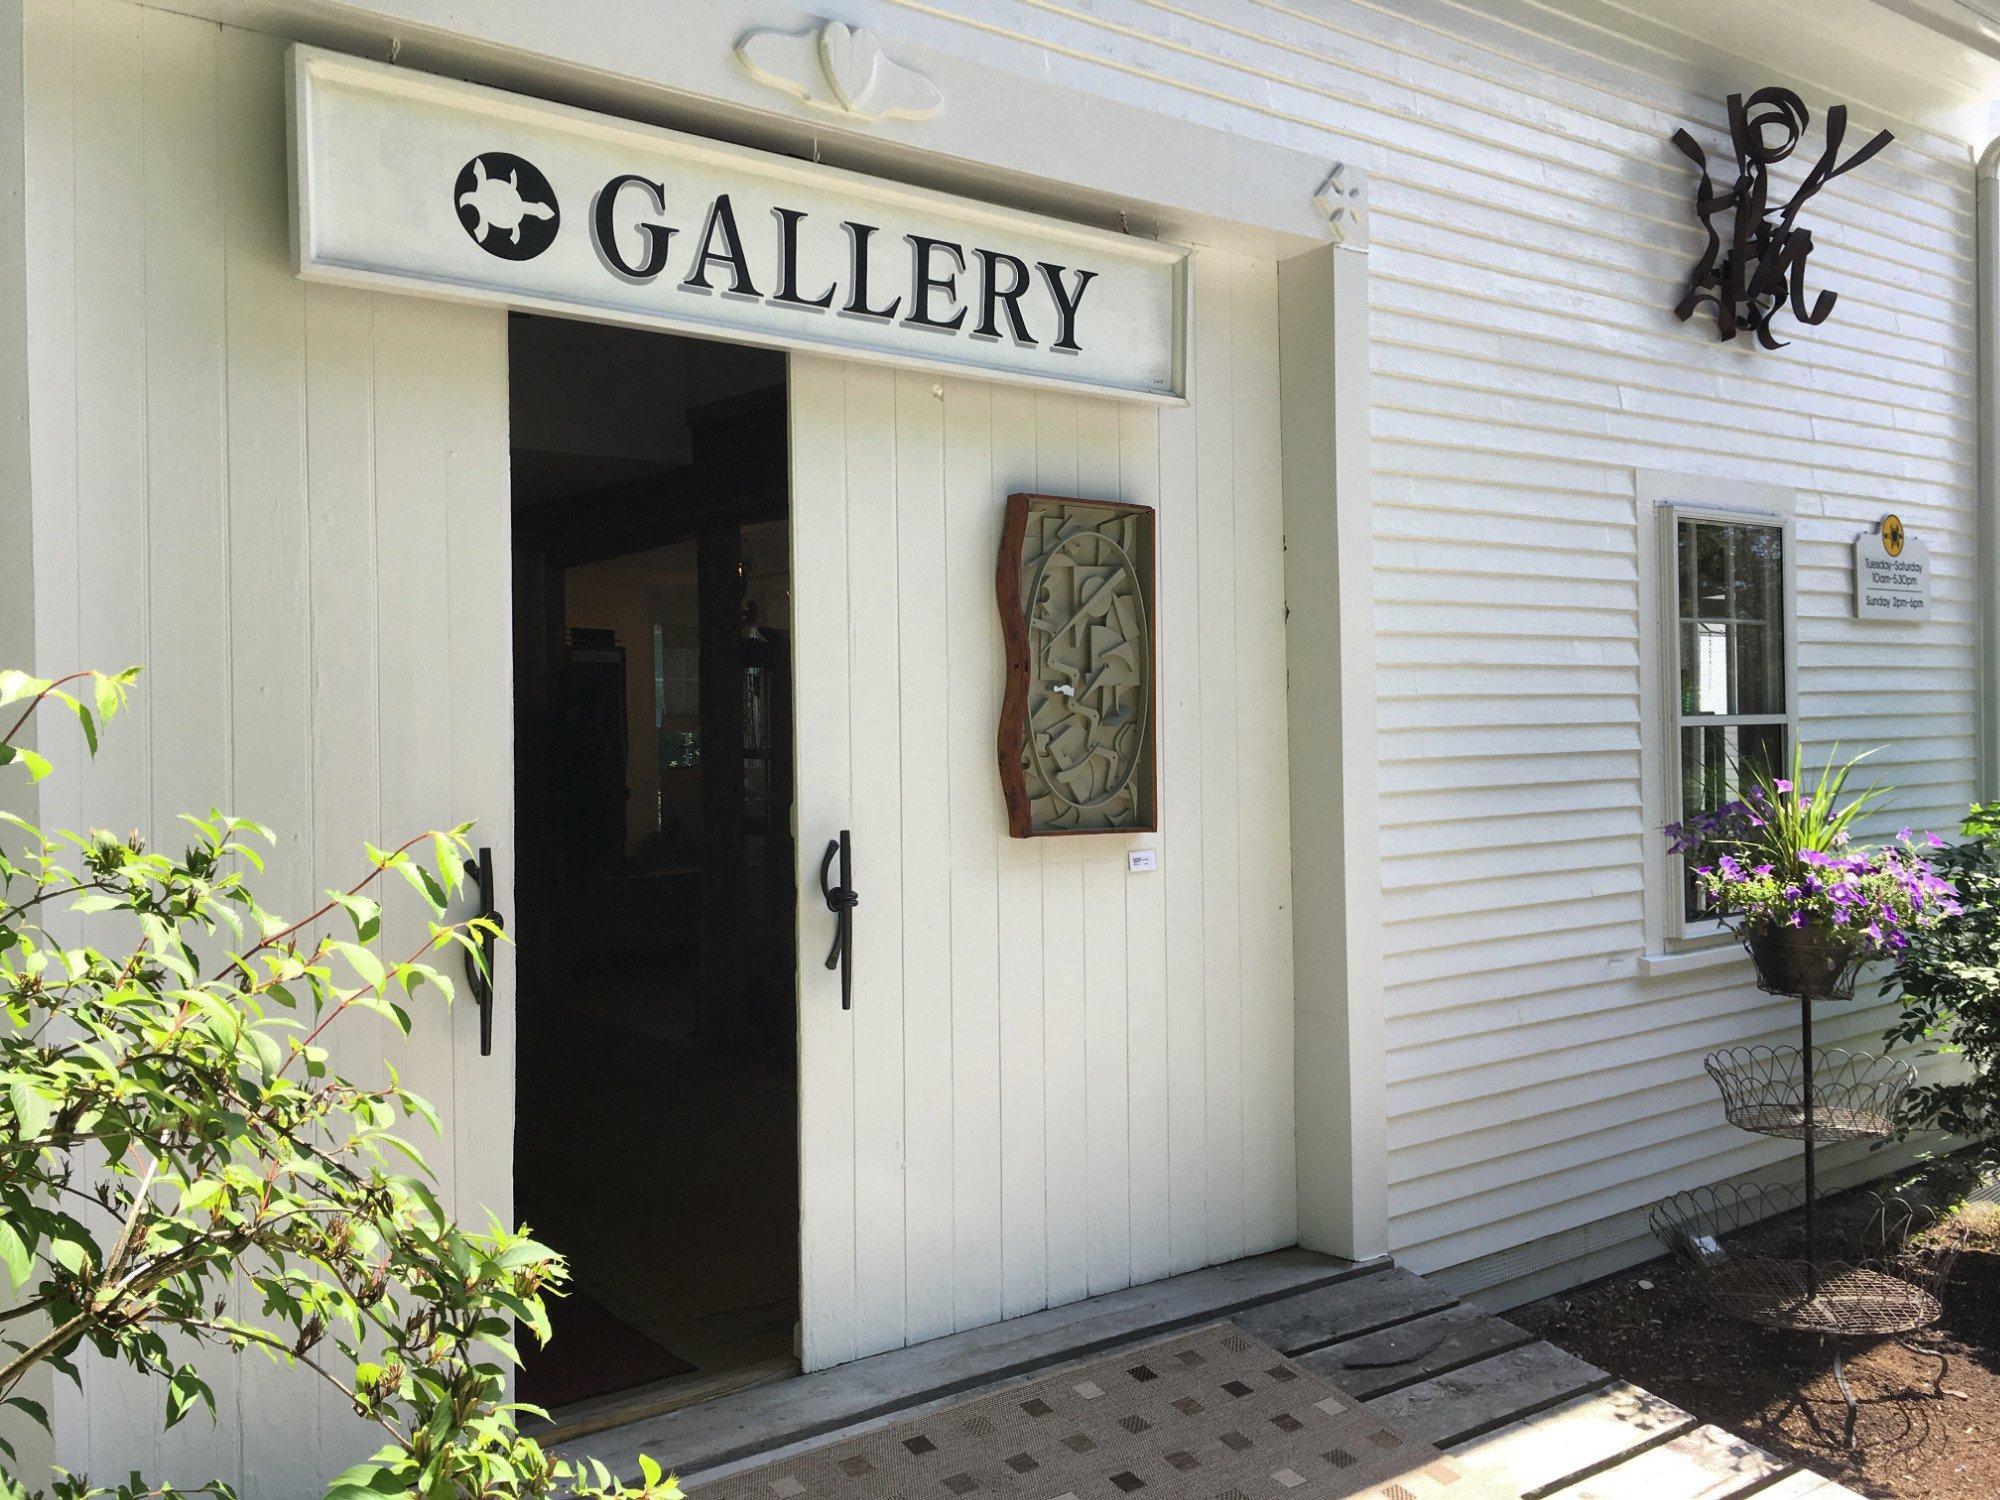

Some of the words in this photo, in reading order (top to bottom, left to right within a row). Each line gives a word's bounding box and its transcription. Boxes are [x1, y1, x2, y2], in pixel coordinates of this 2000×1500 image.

[590, 174, 1098, 354] GALLERY
[1865, 559, 1922, 574] Tuesday-Saturday
[1865, 596, 1890, 609] Sunday
[1892, 597, 1924, 610] 2pm-6pm
